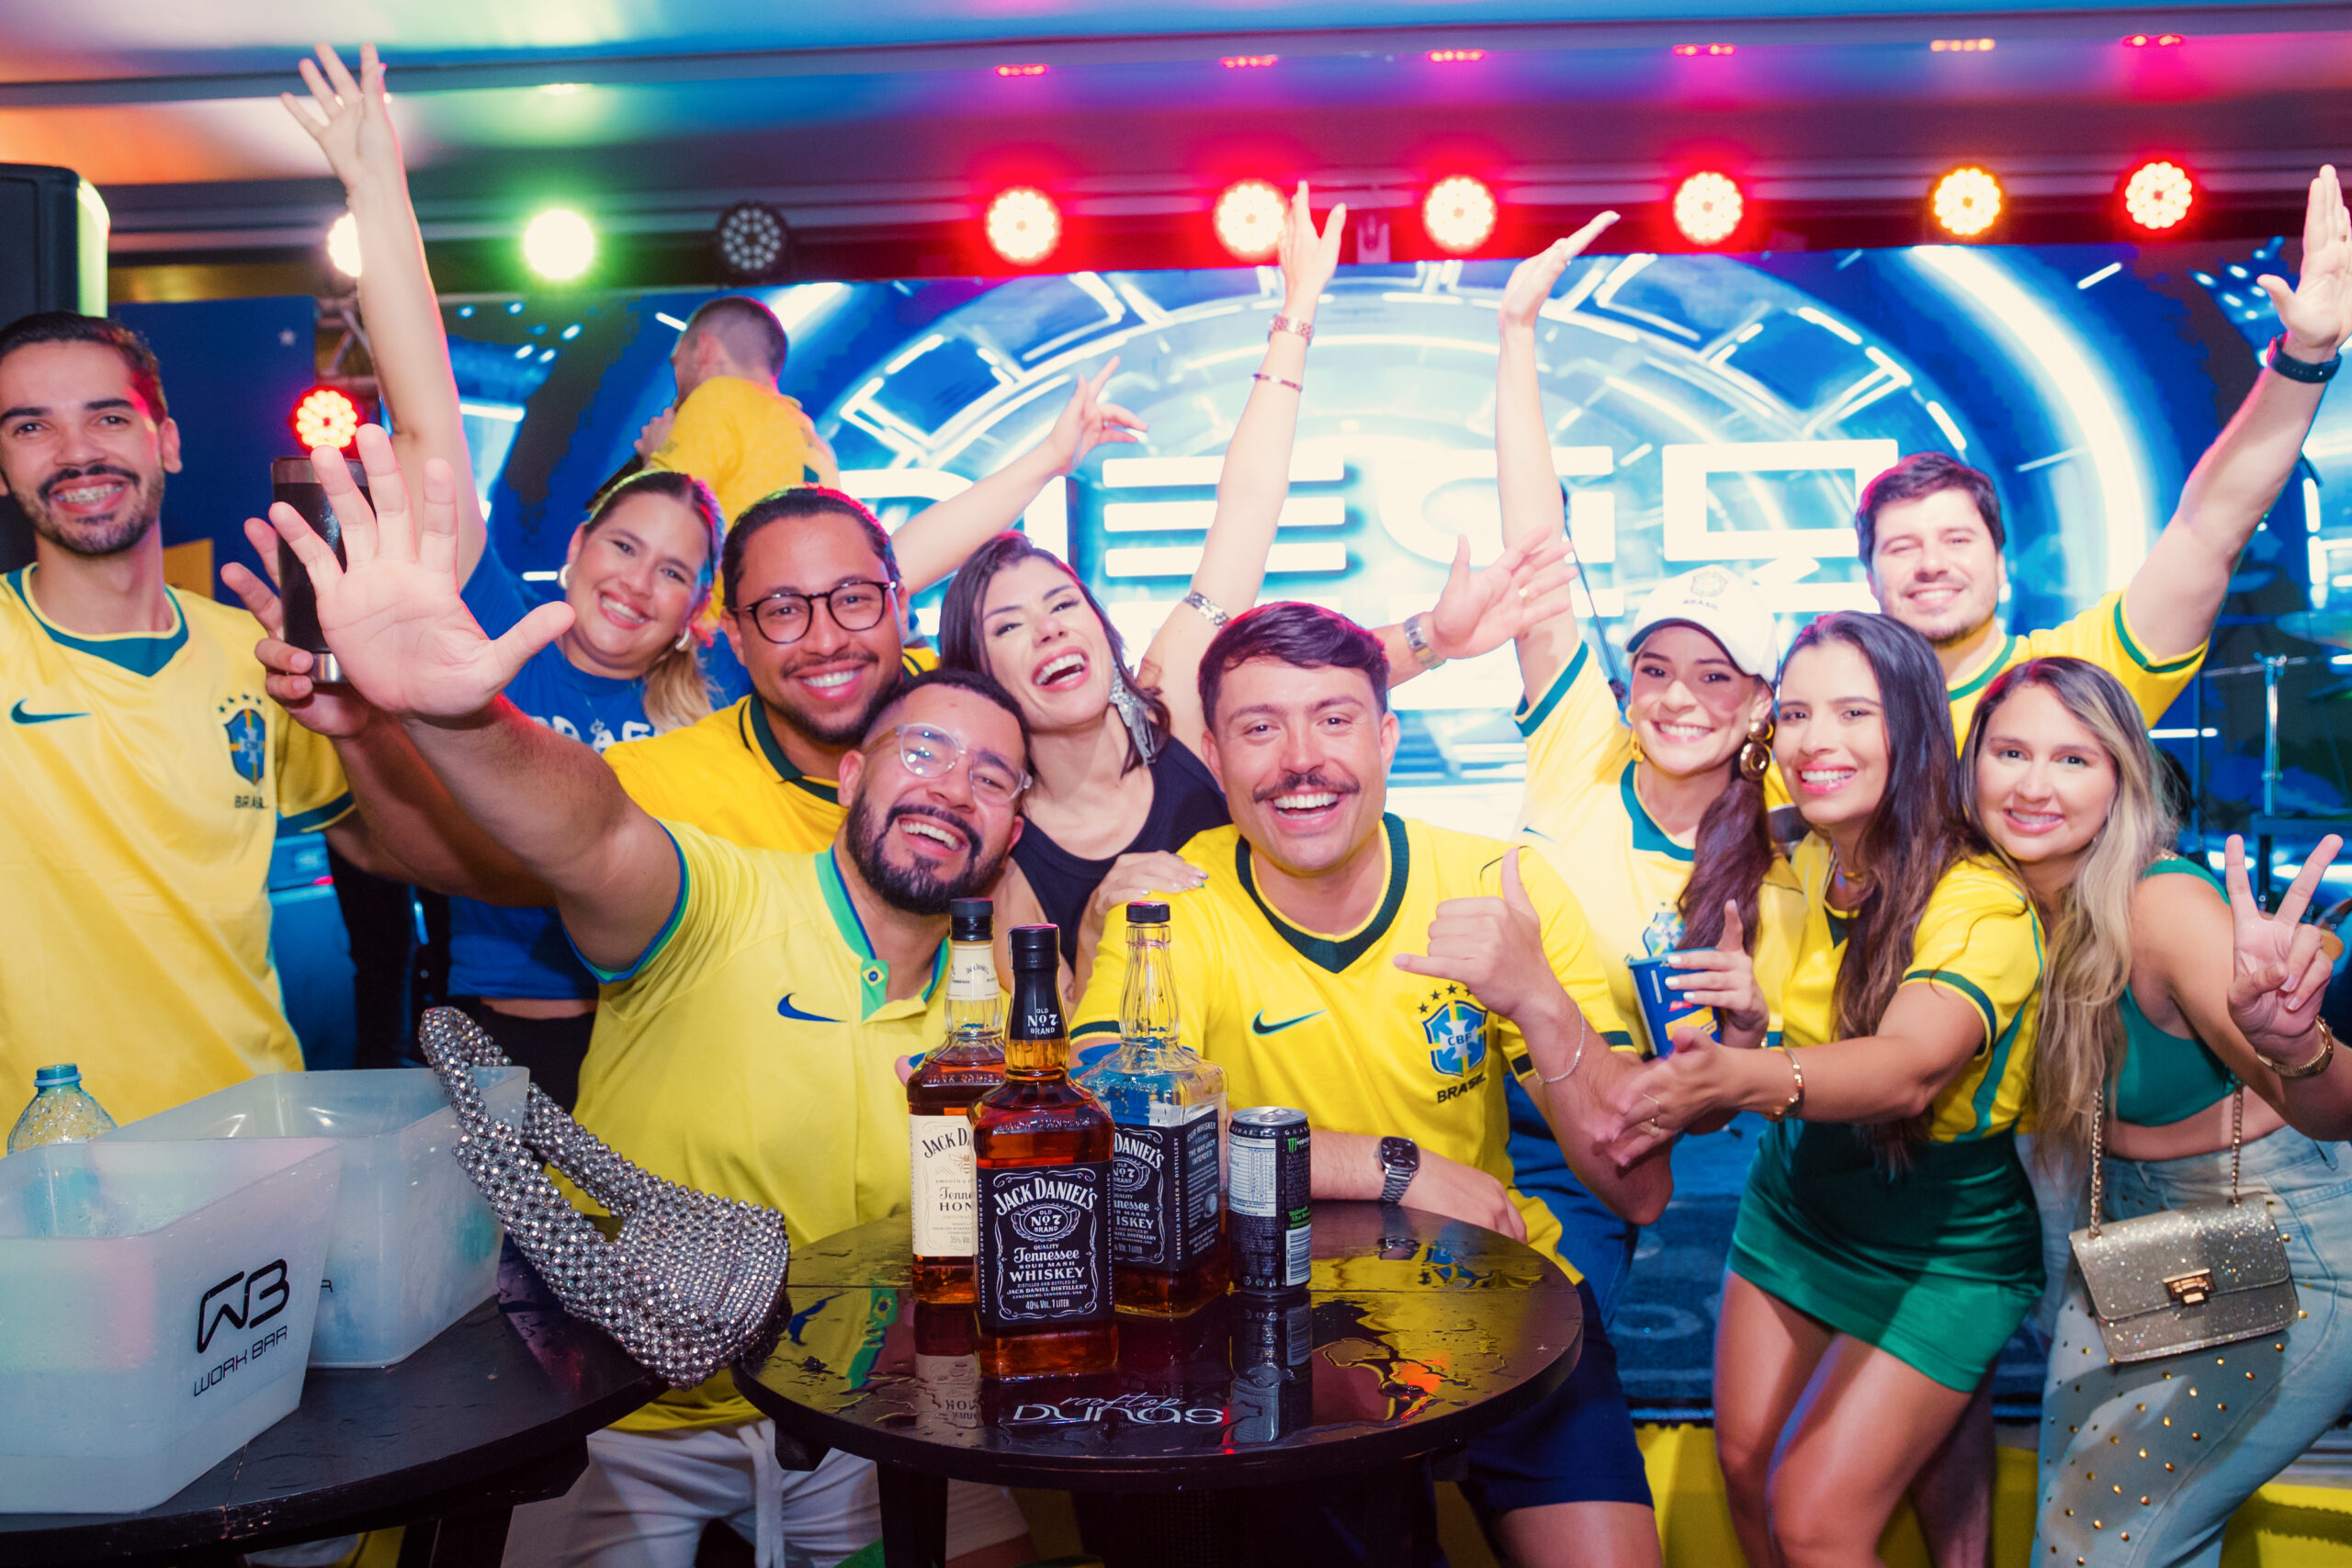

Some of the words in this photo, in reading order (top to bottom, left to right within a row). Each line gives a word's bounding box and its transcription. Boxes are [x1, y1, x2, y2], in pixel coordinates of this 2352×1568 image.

[1447, 1032, 1472, 1046] CBF
[922, 1132, 956, 1158] JACK
[1114, 1132, 1164, 1169] DANIEL'S
[993, 1182, 1034, 1215] JACK
[1035, 1178, 1098, 1212] DANIEL'S
[939, 1202, 972, 1212] HON
[1116, 1215, 1154, 1229] ISKEY
[1013, 1247, 1080, 1263] Tennessee
[1010, 1267, 1085, 1282] WHISKEY
[1025, 1300, 1039, 1310] 40%
[1056, 1298, 1069, 1307] LITER
[194, 1348, 248, 1397] WORK
[252, 1325, 288, 1359] BAR
[1059, 1392, 1187, 1413] rooftop
